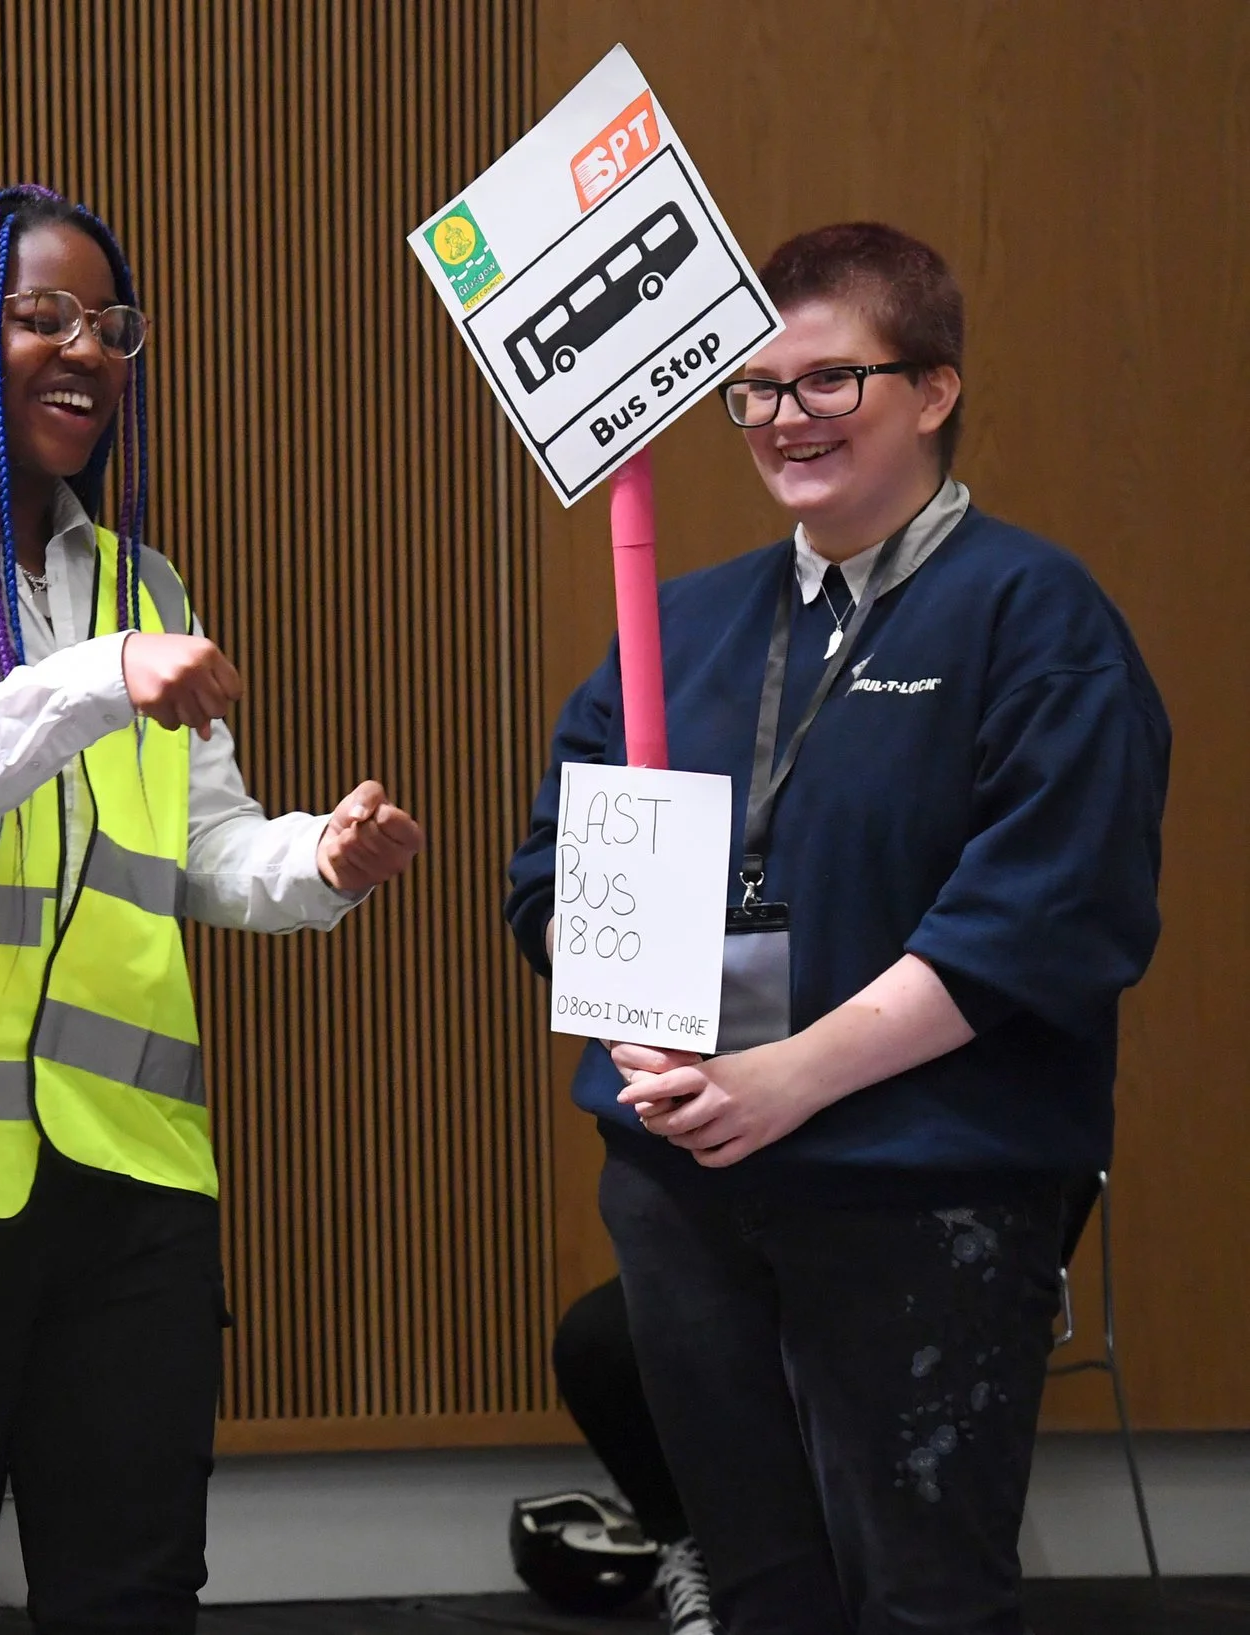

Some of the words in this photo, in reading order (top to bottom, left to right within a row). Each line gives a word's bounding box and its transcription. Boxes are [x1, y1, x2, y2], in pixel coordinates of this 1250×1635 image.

[574, 109, 650, 204] SPT
[458, 262, 495, 296] Glasgow
[466, 294, 480, 308] CITY
[479, 276, 503, 297] COUNCIL
[589, 391, 648, 447] Bus
[650, 331, 721, 397] Stop
[561, 770, 672, 855] LAST
[558, 843, 636, 916] BUS
[556, 994, 603, 1019] 0800
[603, 1002, 612, 1020] I
[617, 1004, 664, 1030] DON'T
[667, 1014, 710, 1036] CARE
